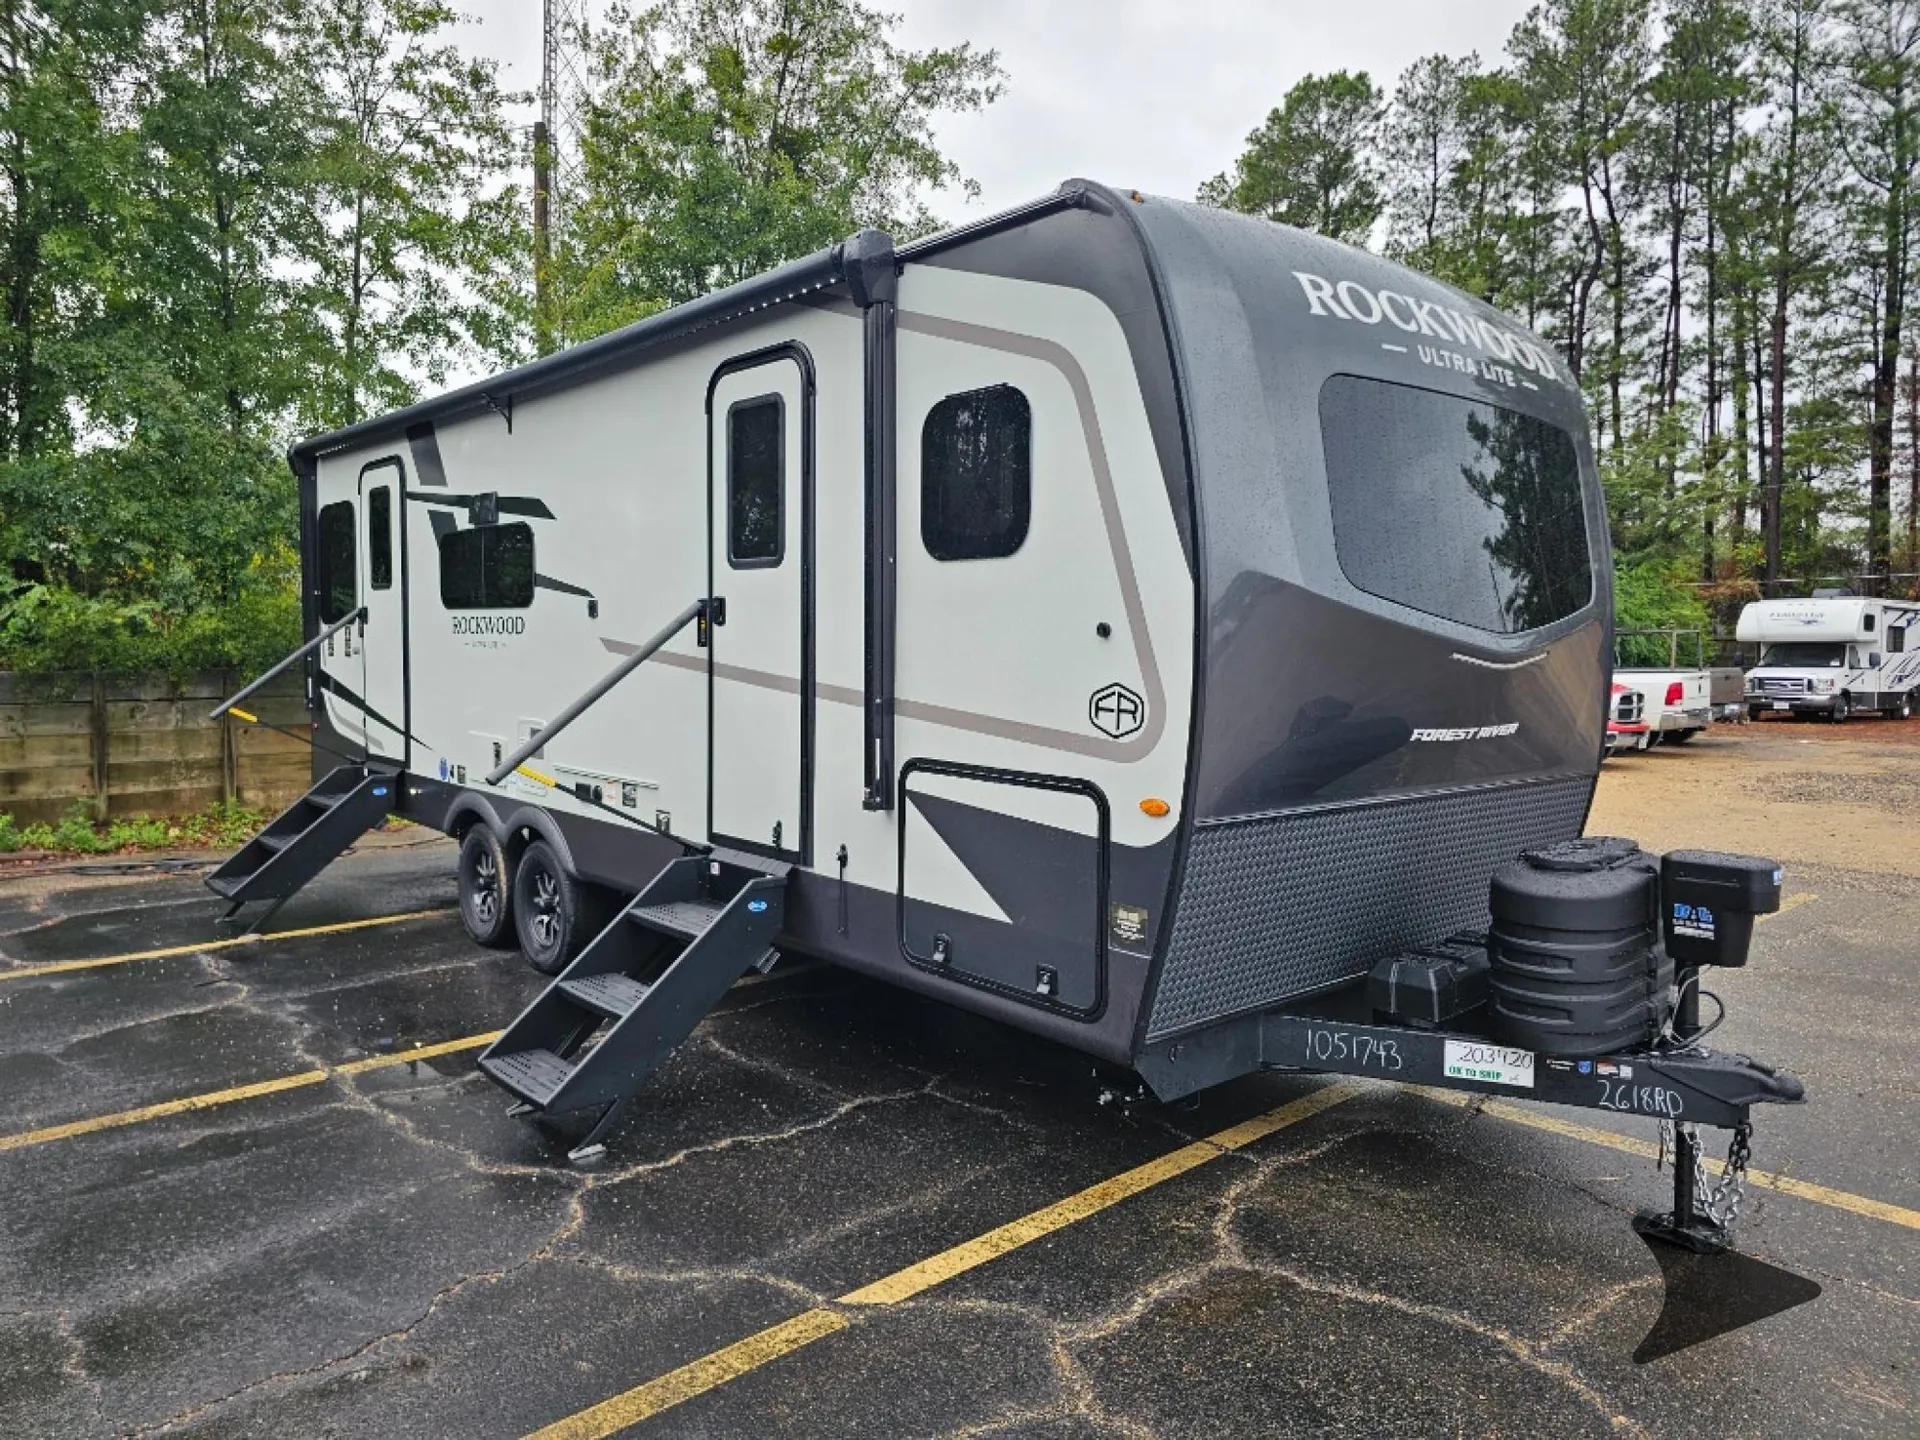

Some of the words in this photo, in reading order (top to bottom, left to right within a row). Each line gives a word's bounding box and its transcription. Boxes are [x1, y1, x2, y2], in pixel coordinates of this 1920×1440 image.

[1292, 271, 1557, 380] ROCKWOOD
[1418, 344, 1479, 376] ULTRA
[1480, 360, 1516, 388] LITE
[451, 616, 526, 635] ROCKWOOD
[1410, 728, 1480, 741] FOREST
[1305, 1028, 1402, 1070] 1051743
[1479, 1069, 1502, 1081] SHIP
[1597, 1079, 1683, 1118] 2618RD
